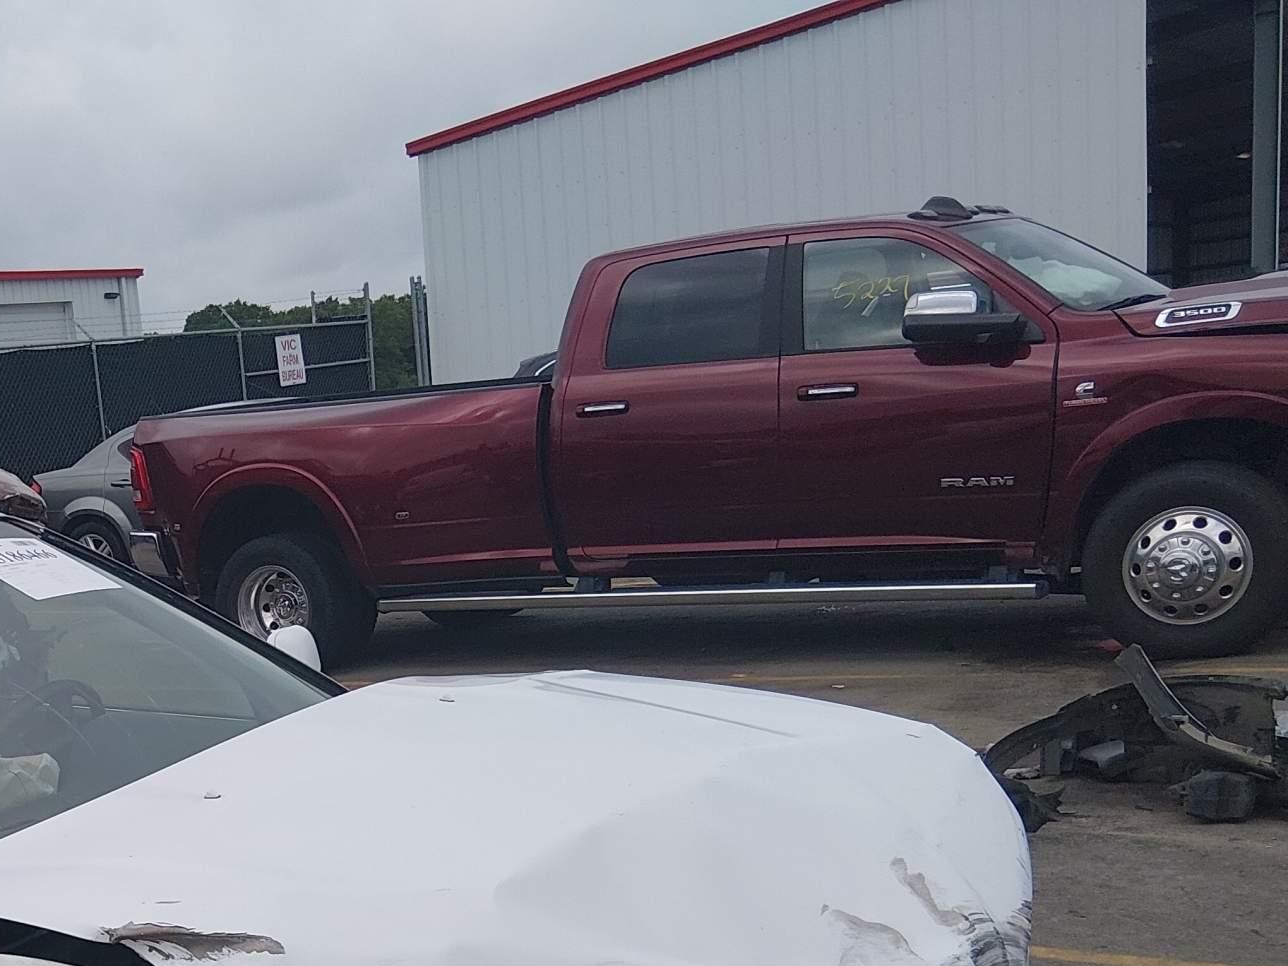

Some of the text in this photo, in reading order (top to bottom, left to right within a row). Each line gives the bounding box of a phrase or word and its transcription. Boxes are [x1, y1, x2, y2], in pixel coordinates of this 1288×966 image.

[1172, 306, 1226, 318] 3500
[280, 339, 297, 351] VIC
[940, 476, 1015, 488] RAM
